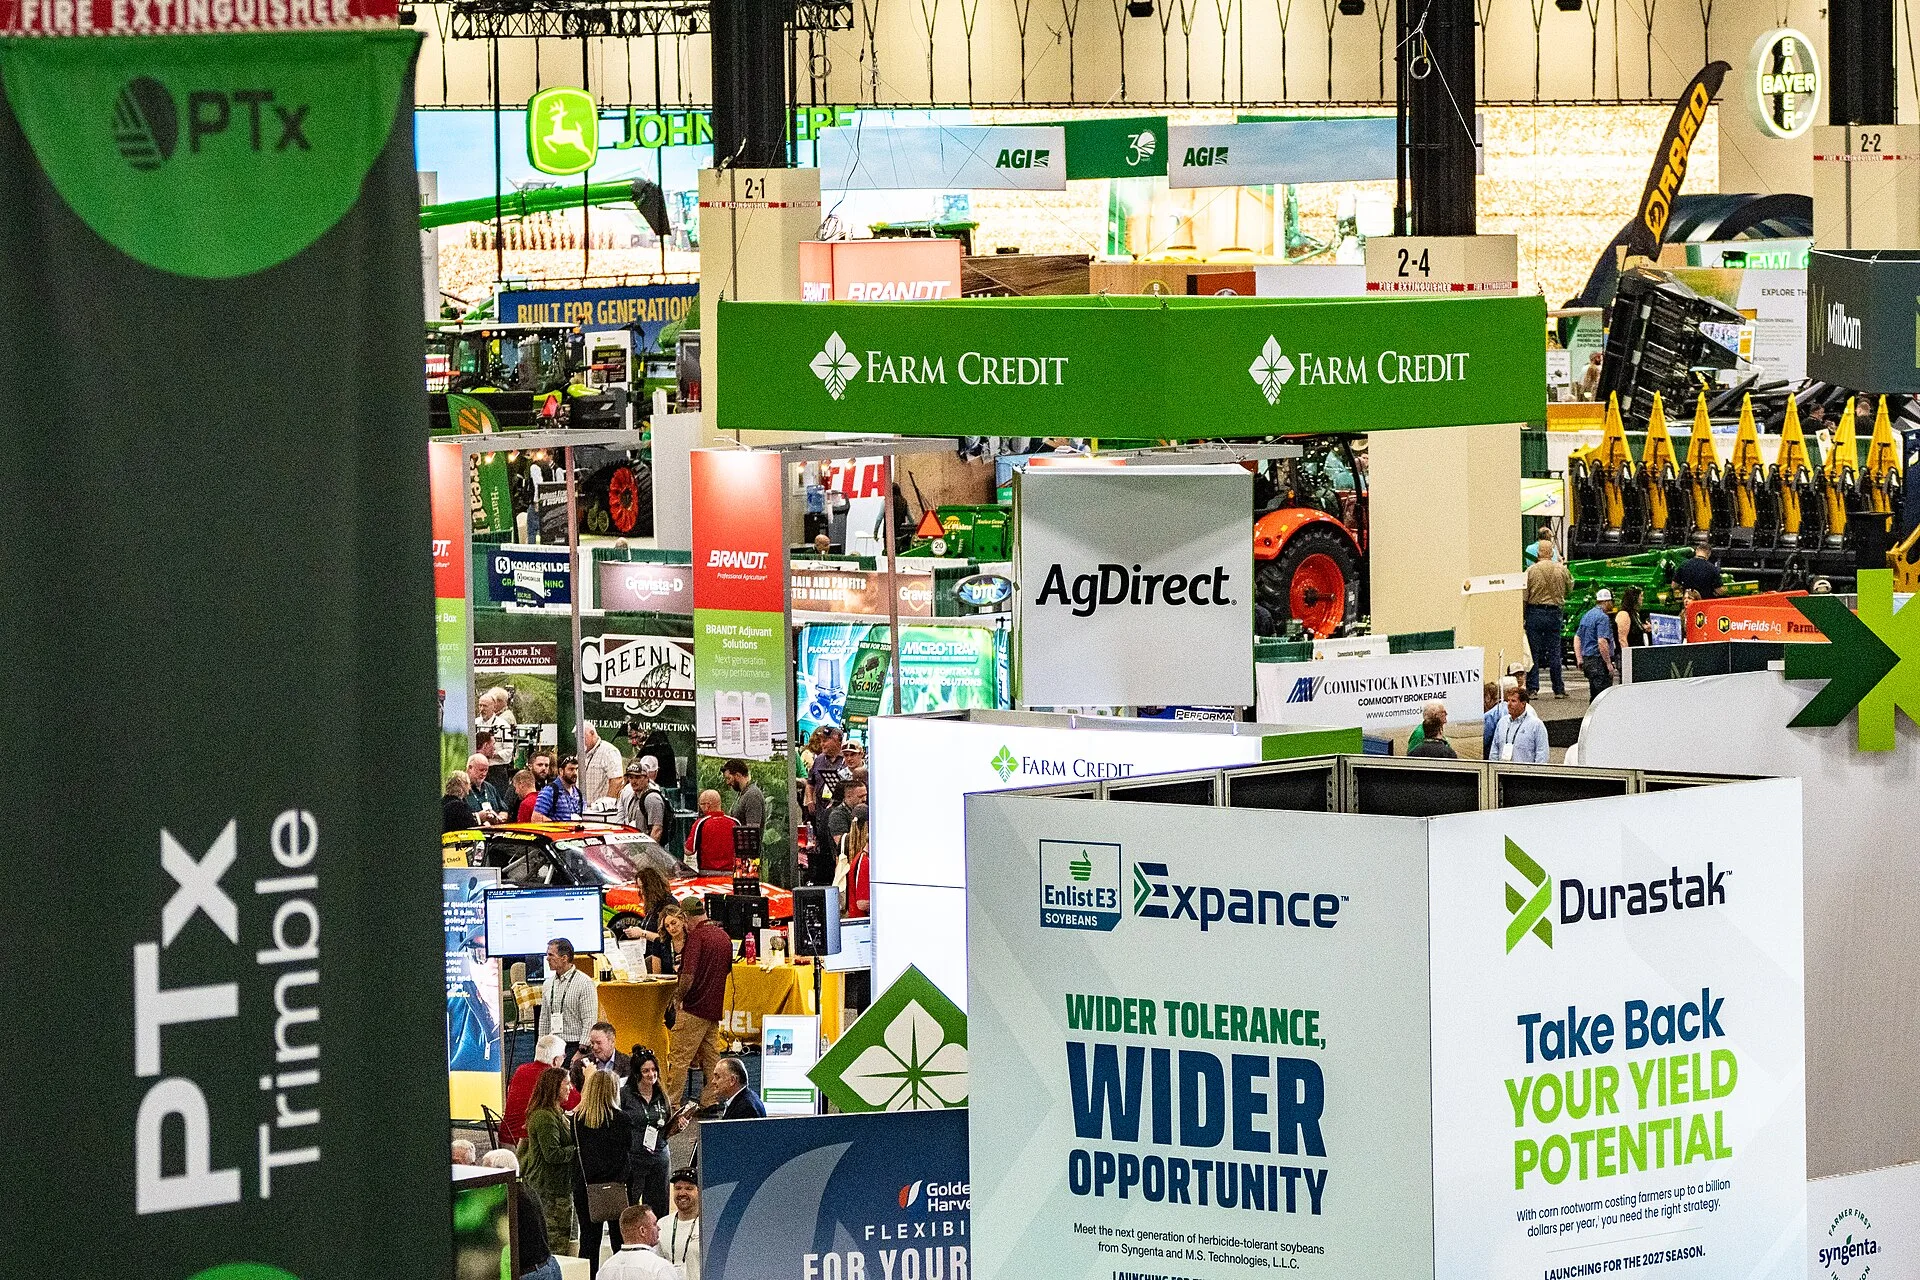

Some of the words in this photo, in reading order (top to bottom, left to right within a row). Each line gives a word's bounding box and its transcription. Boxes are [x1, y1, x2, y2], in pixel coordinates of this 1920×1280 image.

[20, 0, 95, 35] FIRE
[111, 0, 350, 34] EXTINGUISHER
[1762, 73, 1816, 94] BAYER
[189, 91, 312, 152] PTx
[614, 106, 714, 149] JOHN
[1860, 133, 1881, 152] 2-2
[995, 149, 1034, 168] AGI
[1183, 147, 1214, 167] AGI
[1645, 82, 1710, 245] DRAGO
[745, 178, 765, 199] 2-1
[1397, 248, 1431, 277] 2-4
[848, 281, 952, 300] BRANDT
[1761, 288, 1795, 297] EXPLORE
[1827, 301, 1862, 350] Millborn
[865, 350, 948, 384] FARM
[957, 351, 1069, 385] CREDIT
[1298, 352, 1369, 386] FARM
[1377, 350, 1470, 385] CREDIT
[934, 541, 945, 550] 20
[511, 561, 571, 573] KONGSKILDE
[707, 550, 769, 569] BRANDT
[545, 580, 565, 588] NING
[717, 572, 743, 580] Professional
[443, 613, 457, 622] Box
[1771, 621, 1782, 633] Ag
[705, 624, 738, 635] BRANDT
[739, 626, 773, 638] Adjuvant
[475, 648, 493, 656] THE
[494, 647, 528, 656] LEADER
[531, 647, 541, 656] IN
[722, 639, 758, 650] Solutions
[500, 657, 551, 665] INNOVATION
[714, 653, 731, 664] Next
[731, 656, 767, 667] generation
[729, 668, 770, 679] performance
[1324, 676, 1399, 695] COMMSTOCK
[1401, 668, 1480, 690] INVESTMENTS
[607, 687, 694, 700] TECHNOLOGIE
[1357, 695, 1403, 707] COMMODITY
[1403, 691, 1447, 702] BROKERAGE
[599, 720, 623, 729] LEADE
[639, 722, 652, 731] AIR
[1022, 756, 1066, 776] FARM
[1073, 758, 1134, 778] CREDIT
[1044, 884, 1094, 908] Enlist
[1095, 887, 1118, 909] E3
[1045, 912, 1098, 927] SOYBEANS
[254, 809, 321, 1199] Trimble
[133, 818, 241, 1214] PTx
[1065, 993, 1157, 1036] WIDER
[1164, 1000, 1326, 1050] TOLERANCE,
[1517, 1006, 1615, 1063] Take
[1625, 987, 1726, 1050] Back
[1504, 1064, 1620, 1128] YOUR
[1627, 1048, 1738, 1111] YIELD
[1066, 1041, 1328, 1158] WIDER
[1514, 1110, 1733, 1190] POTENTIAL
[926, 1181, 970, 1197] Golde
[1068, 1149, 1328, 1216] OPPORTUNITY
[928, 1198, 971, 1212] Harve
[1516, 1209, 1537, 1222] With
[1539, 1207, 1559, 1219] corn
[1560, 1201, 1603, 1216] rootworm
[1604, 1194, 1637, 1209] costing
[1638, 1188, 1672, 1204] farmers
[1674, 1187, 1686, 1200] up
[1687, 1184, 1696, 1195] to
[1697, 1185, 1704, 1194] a
[1705, 1179, 1731, 1192] billion
[1527, 1222, 1558, 1238] dollars
[1560, 1221, 1574, 1236] per
[1601, 1214, 1618, 1229] you
[1619, 1209, 1643, 1222] need
[1644, 1206, 1659, 1219] the
[1661, 1203, 1681, 1219] right
[1683, 1198, 1721, 1214] strategy.
[1828, 1208, 1853, 1237] FARMER
[1854, 1208, 1872, 1230] FIRST
[1073, 1222, 1097, 1235] Meet
[1098, 1225, 1113, 1237] the
[1115, 1227, 1135, 1239] next
[1137, 1229, 1185, 1244] generation
[1186, 1233, 1197, 1244] of
[1198, 1233, 1278, 1251] herbicide-tolerant
[1280, 1241, 1325, 1256] soybeans
[803, 1251, 865, 1280] FOR
[878, 1246, 968, 1280] YOUR
[1098, 1241, 1119, 1253] from
[1121, 1243, 1164, 1258] Syngenta
[1166, 1246, 1183, 1259] and
[1185, 1250, 1206, 1261] M.S.
[1208, 1251, 1271, 1268] Technologies,
[1273, 1257, 1300, 1270] L.L.C.
[1544, 1262, 1602, 1280] LAUNCHING
[1603, 1259, 1622, 1273] FOR
[1623, 1255, 1641, 1269] THE
[1642, 1252, 1665, 1266] 2027
[1666, 1245, 1706, 1262] SEASON.
[1818, 1238, 1877, 1269] syngenta
